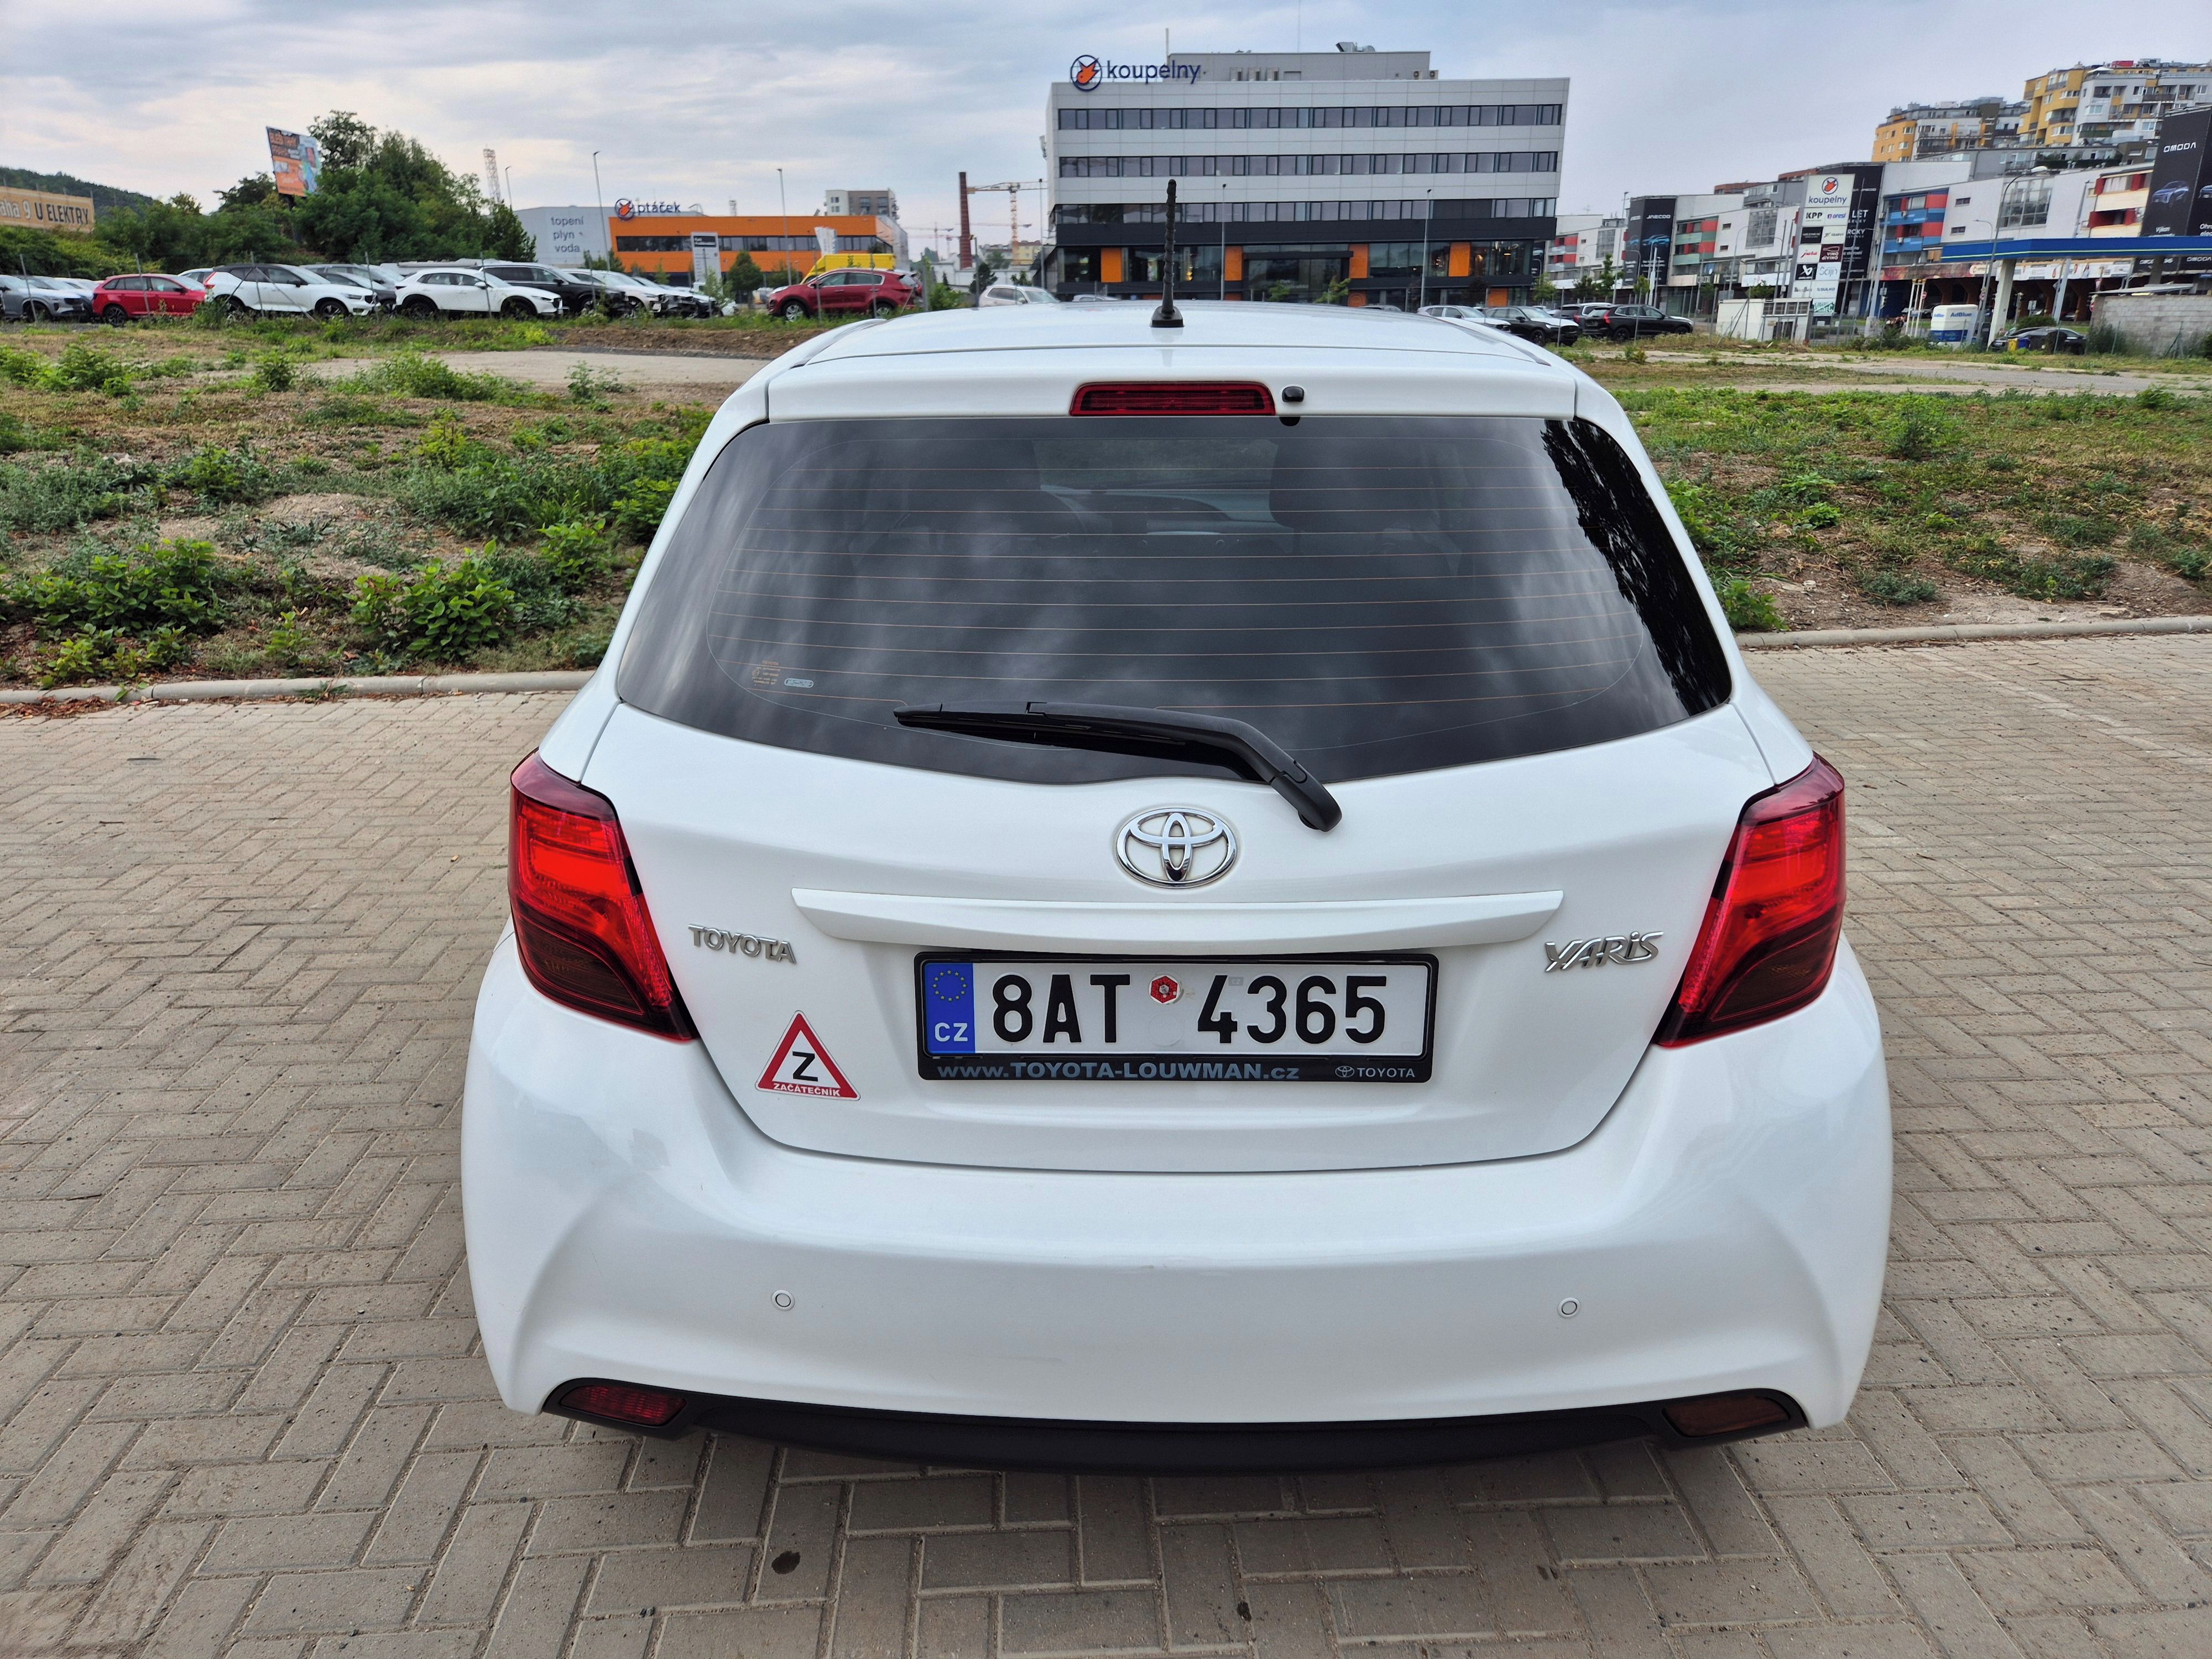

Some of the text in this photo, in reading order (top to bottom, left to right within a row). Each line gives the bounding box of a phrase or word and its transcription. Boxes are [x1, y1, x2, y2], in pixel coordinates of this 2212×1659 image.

[1107, 60, 1201, 84] koupelny
[2163, 142, 2197, 153] OMODA
[1808, 196, 1847, 205] koupelny
[23, 199, 31, 220] 9
[34, 202, 43, 220] U
[46, 204, 89, 225] ELEKTRY
[638, 201, 681, 216] ptáček
[551, 216, 584, 227] topení
[554, 230, 575, 240] plyn
[555, 243, 580, 253] voda
[687, 924, 797, 964] TOYOTA
[992, 974, 1387, 1044] 8AT 4365
[934, 1022, 968, 1042] CZ
[792, 1050, 818, 1082] Z
[937, 1062, 1300, 1079] www.TOYOTA-LOUWMAN.cz
[1357, 1067, 1416, 1078] TOYOTA
[773, 1082, 841, 1097] ZAČÁTEČNÍK
